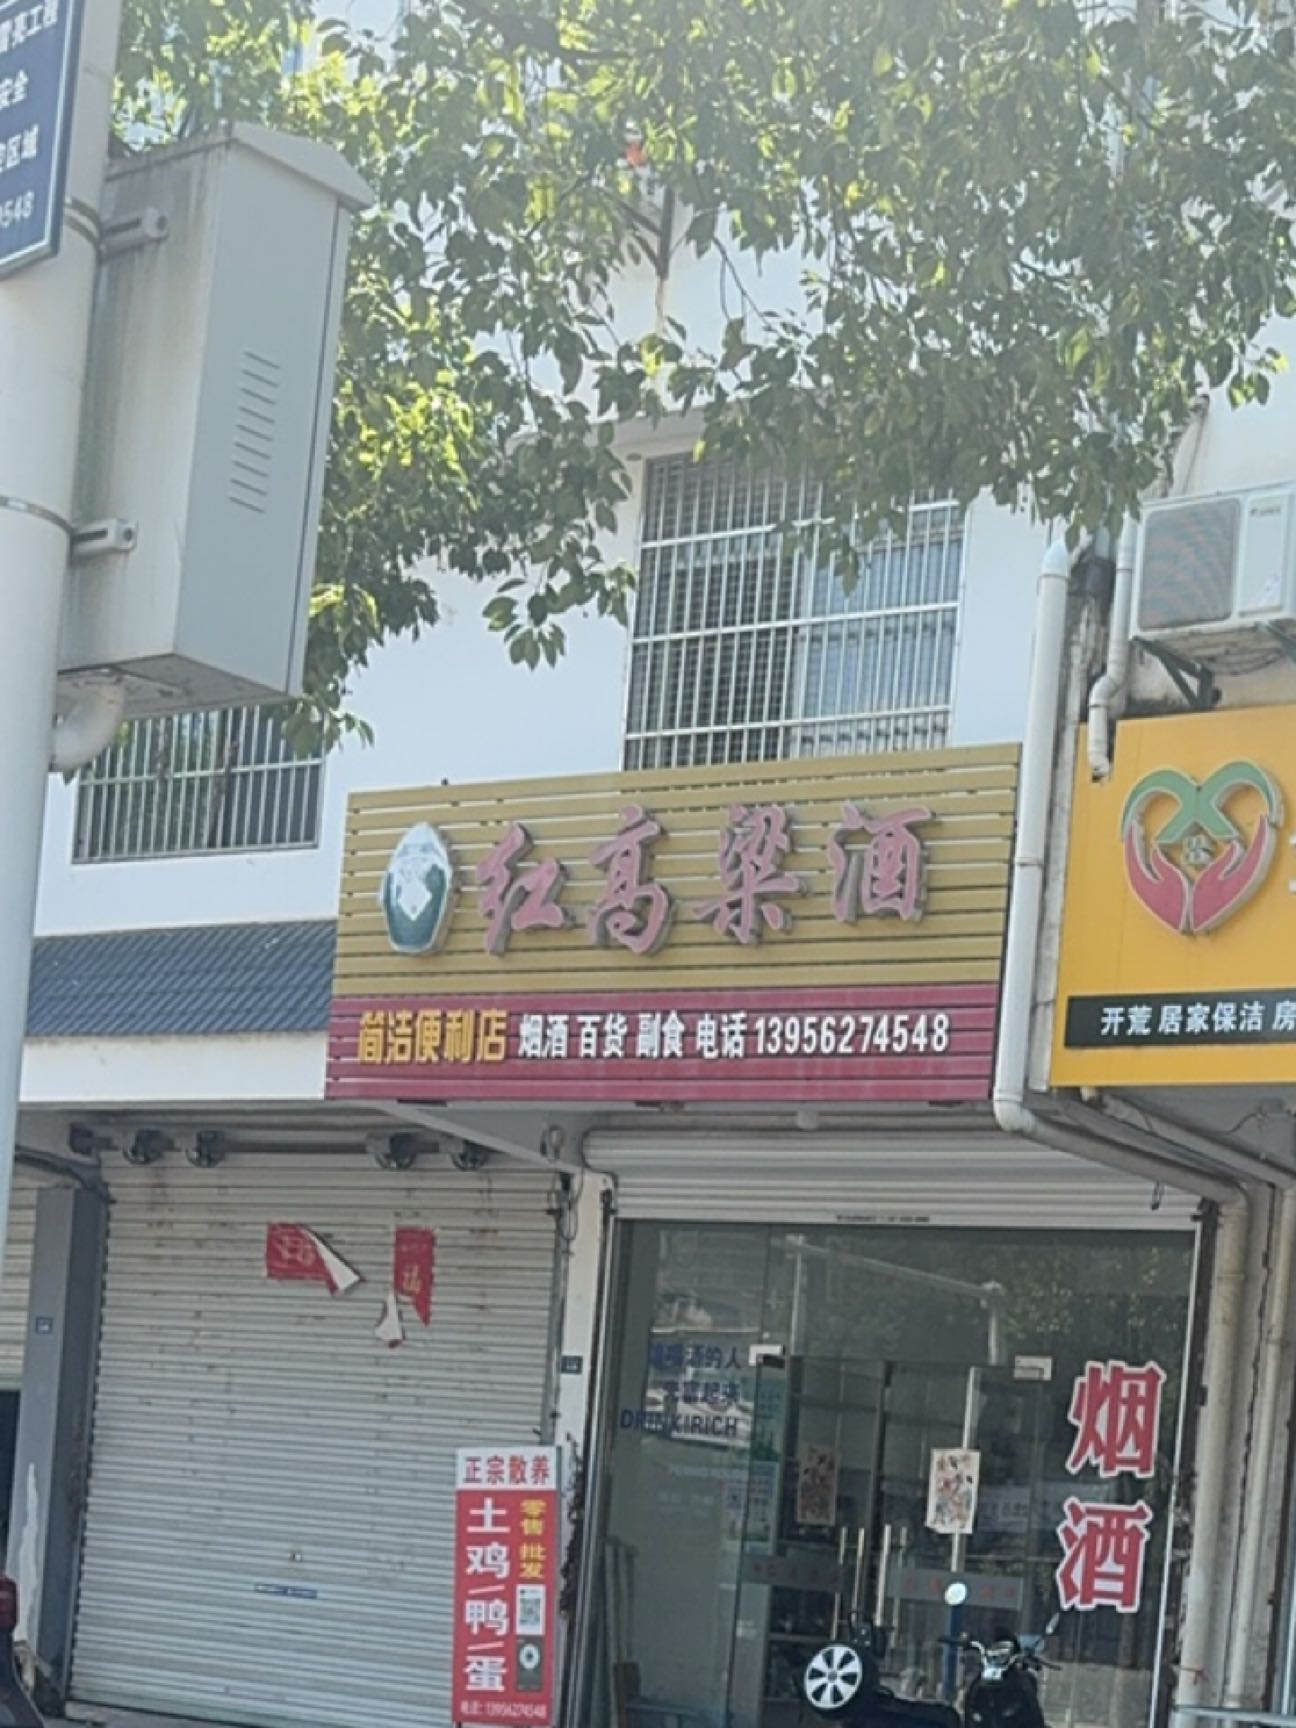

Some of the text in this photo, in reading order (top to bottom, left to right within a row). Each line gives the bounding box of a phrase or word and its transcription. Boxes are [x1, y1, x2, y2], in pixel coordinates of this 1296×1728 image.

[1101, 1004, 1152, 1036] 开荒
[1158, 1001, 1265, 1034] 居家保洁
[463, 1455, 550, 1485] 正宗散养
